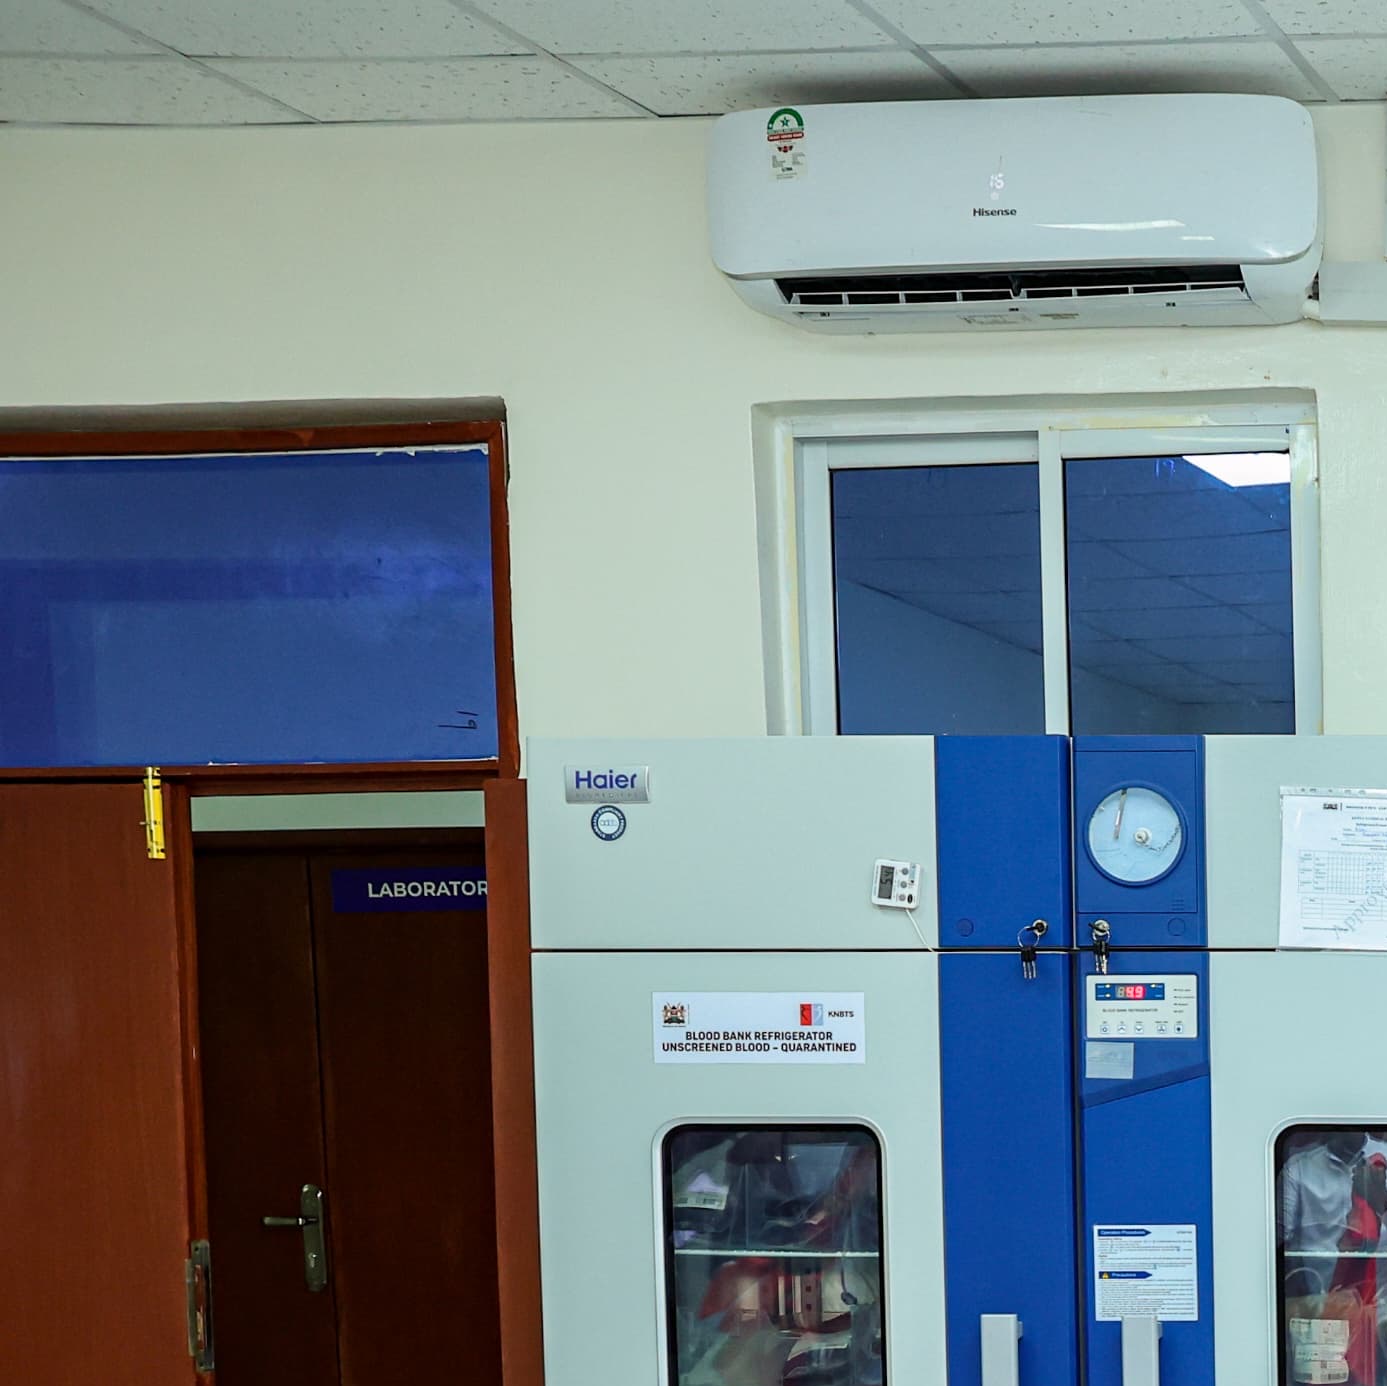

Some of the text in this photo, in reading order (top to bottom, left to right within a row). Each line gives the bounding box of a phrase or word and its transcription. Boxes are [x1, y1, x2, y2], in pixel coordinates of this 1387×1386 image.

[973, 208, 1017, 217] Hisense
[575, 769, 638, 790] Haier
[686, 1032, 833, 1041] BLOOD BANK REFRIGERATOR
[662, 1043, 733, 1052] UNSCREENED
[735, 1043, 770, 1052] BLOOD
[781, 1043, 857, 1052] QUARANTINED
